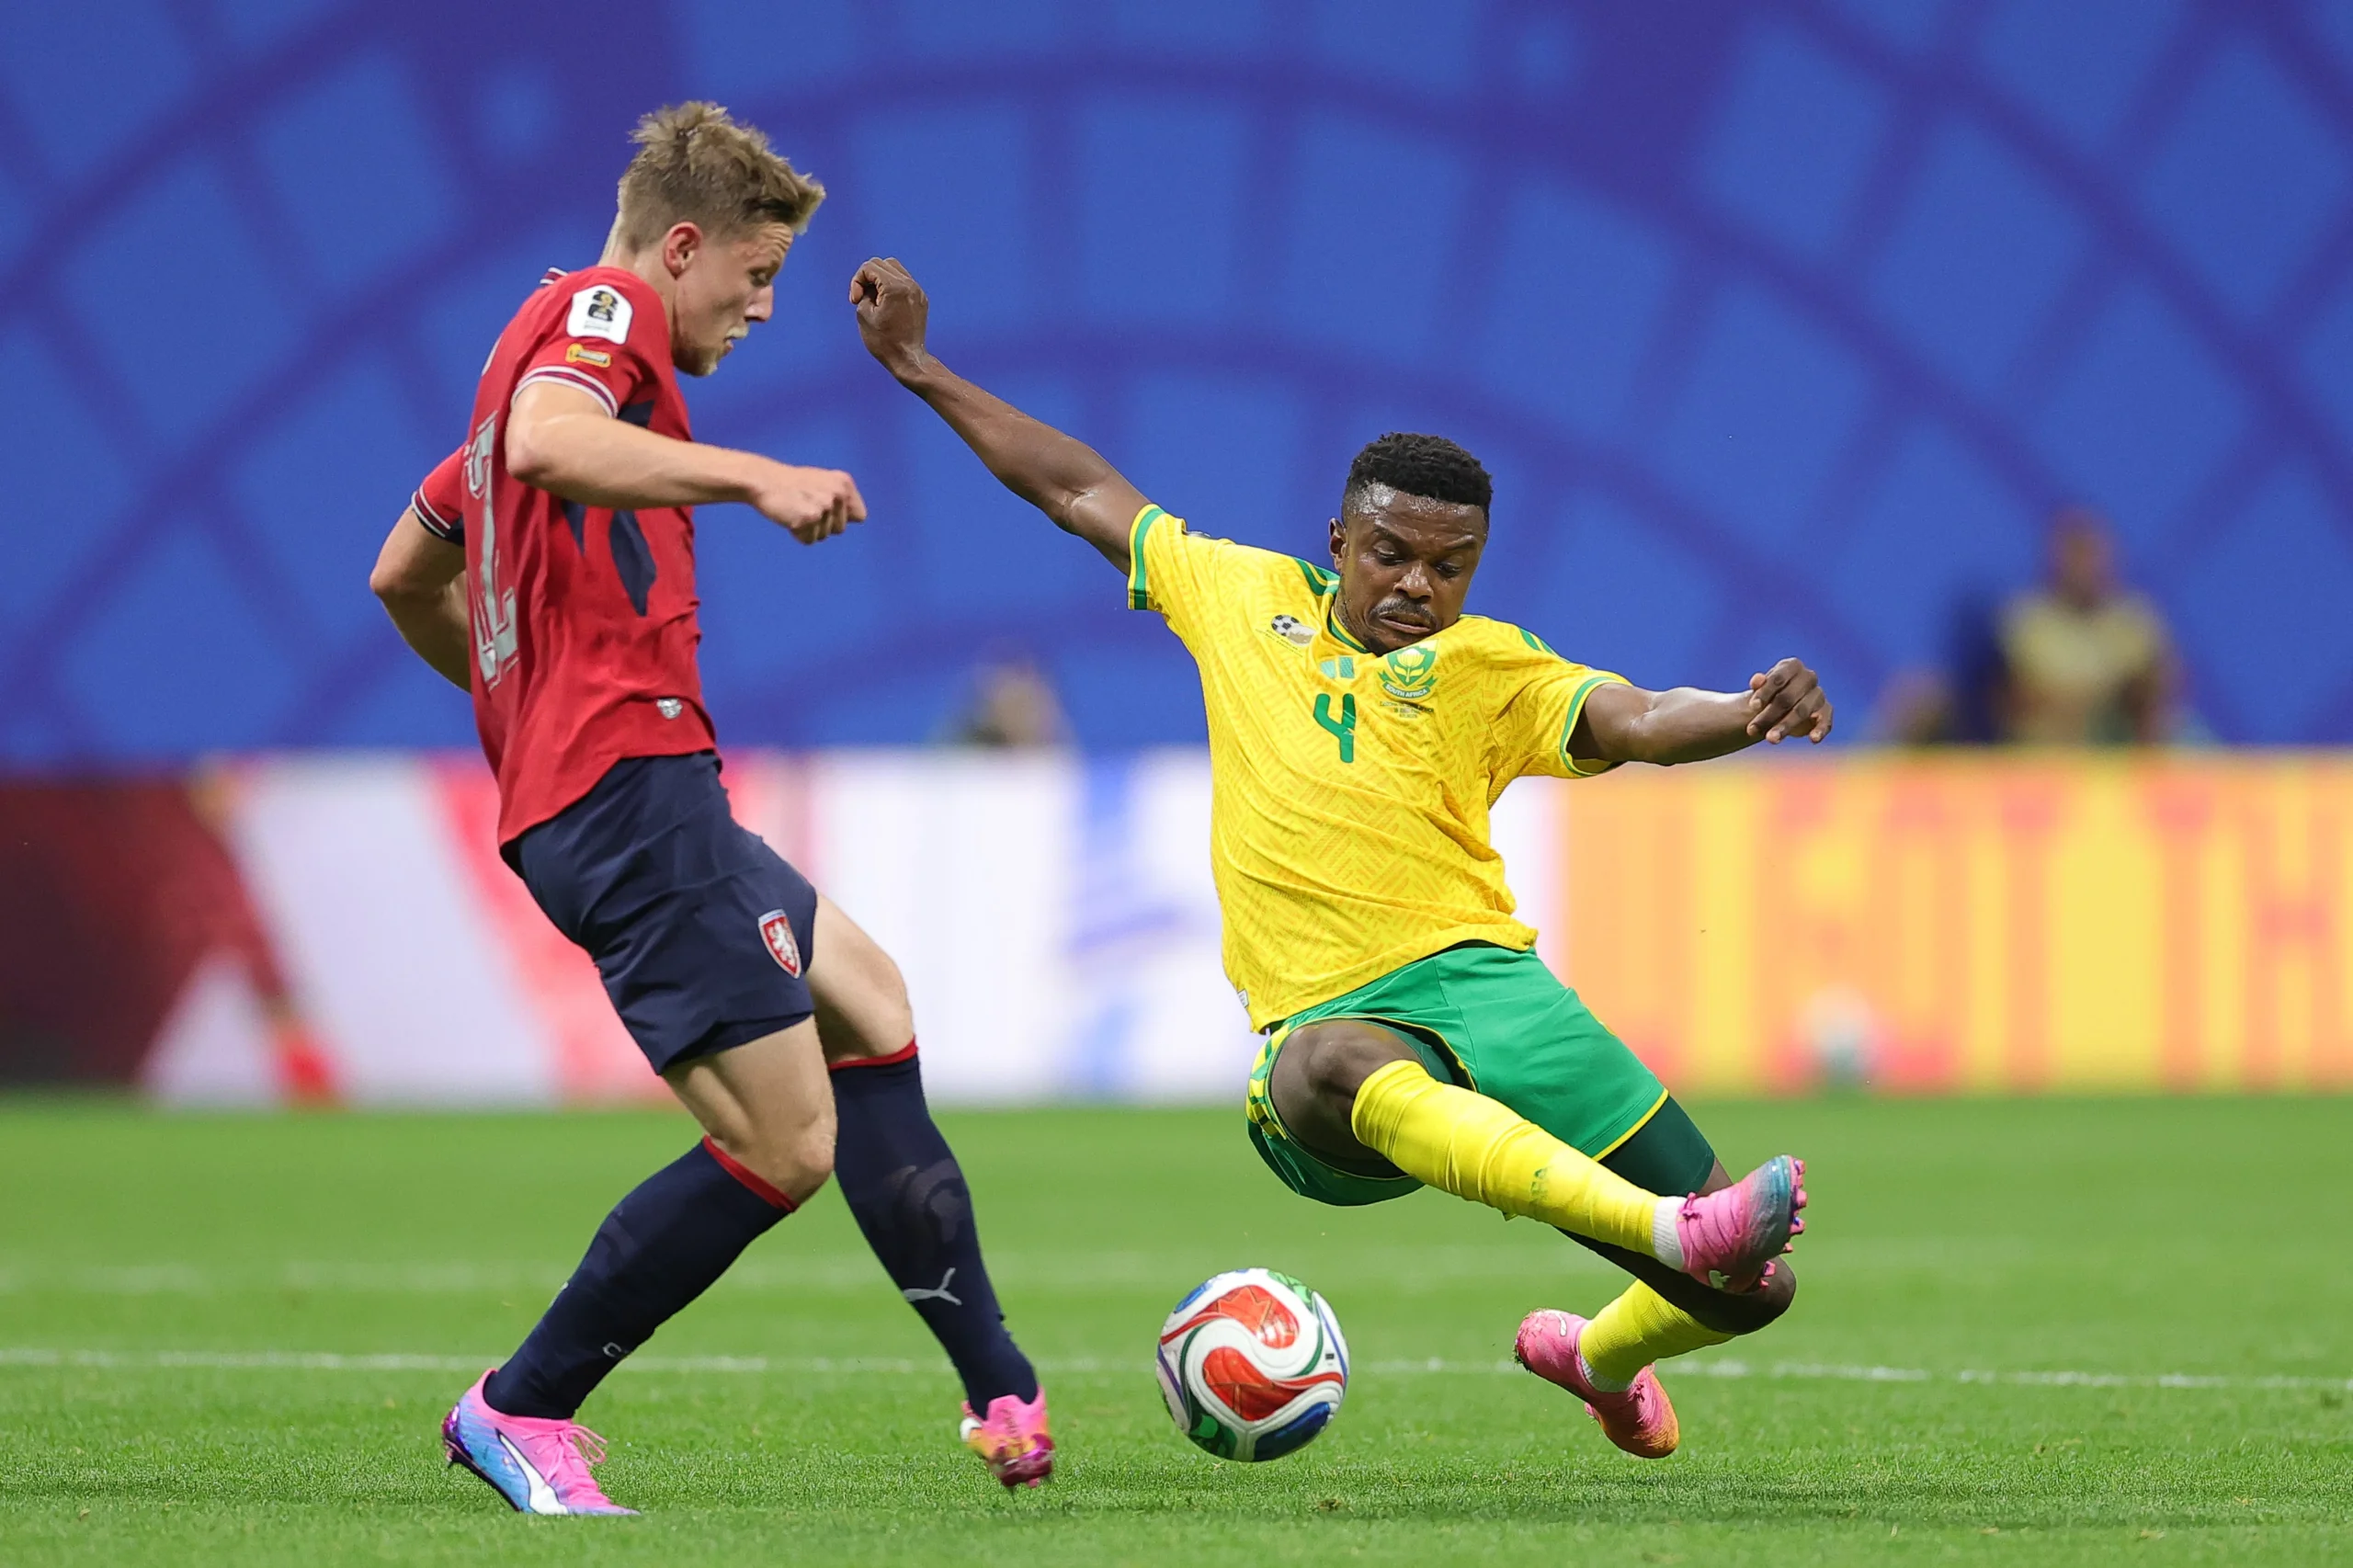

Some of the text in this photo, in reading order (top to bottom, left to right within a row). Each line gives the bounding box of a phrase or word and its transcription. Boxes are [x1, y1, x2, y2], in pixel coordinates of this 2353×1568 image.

[1385, 684, 1427, 698] SOUTH AFRICA
[1313, 693, 1357, 764] 4
